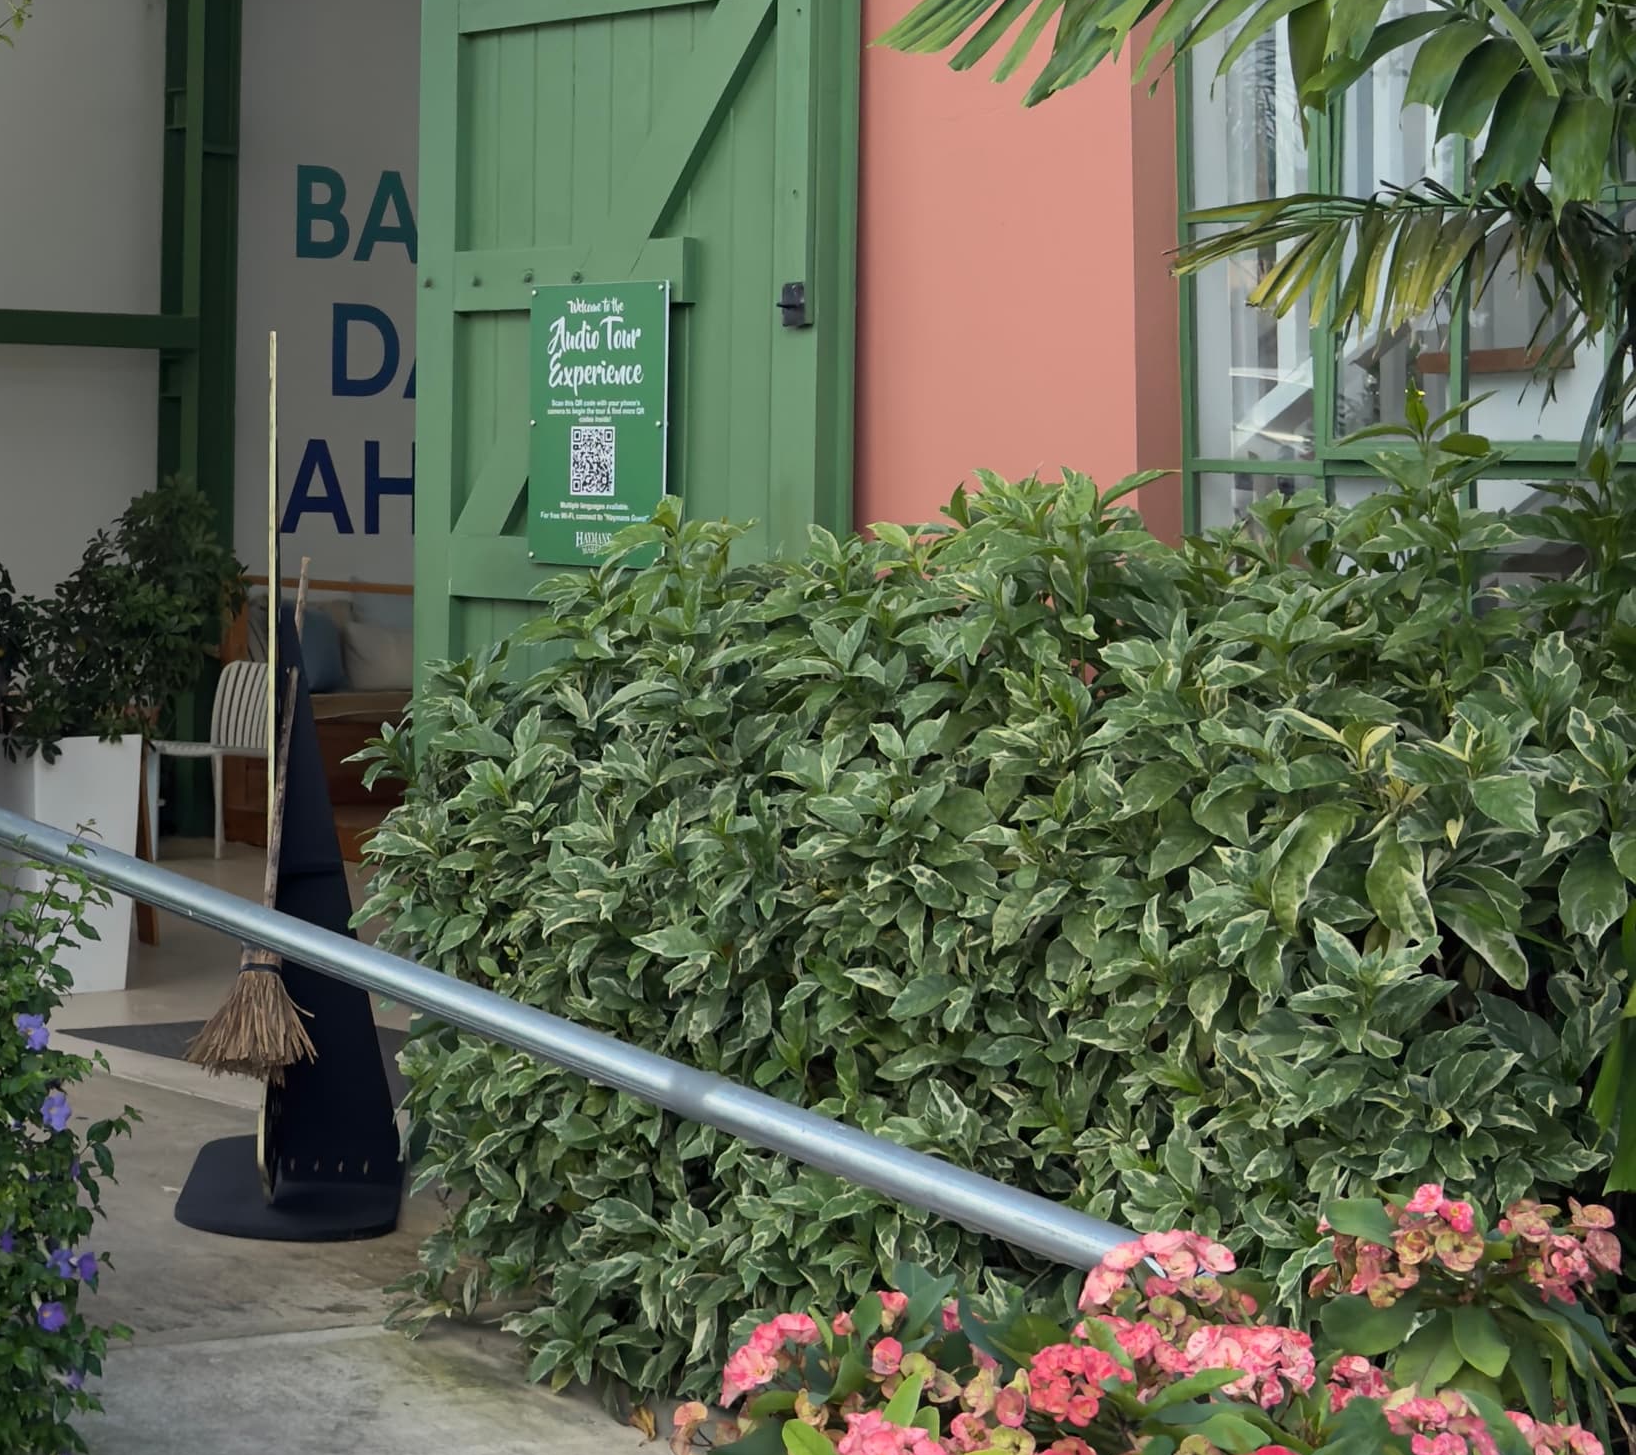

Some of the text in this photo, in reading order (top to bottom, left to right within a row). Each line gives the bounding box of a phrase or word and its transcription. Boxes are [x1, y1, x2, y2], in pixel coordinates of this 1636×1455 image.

[567, 297, 624, 315] Welcome to the
[331, 302, 417, 399] D
[547, 315, 642, 355] Audio Tour
[548, 349, 645, 397] Experience
